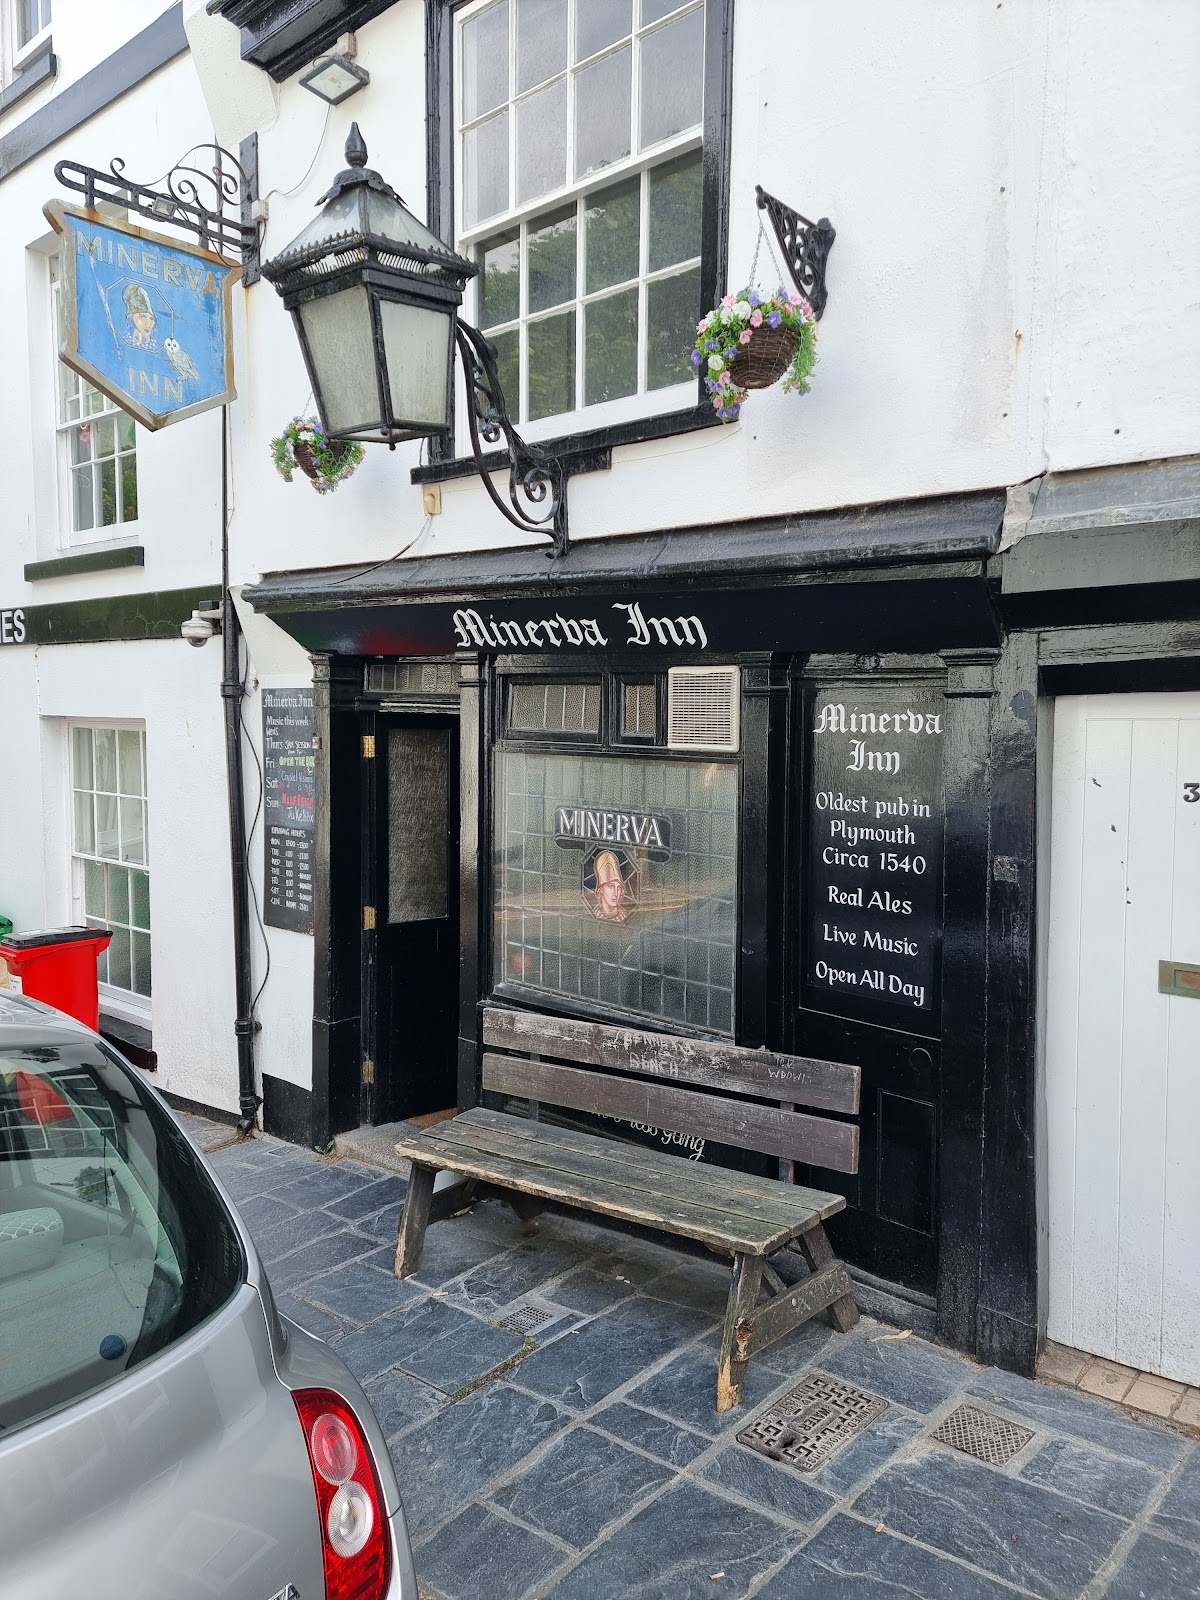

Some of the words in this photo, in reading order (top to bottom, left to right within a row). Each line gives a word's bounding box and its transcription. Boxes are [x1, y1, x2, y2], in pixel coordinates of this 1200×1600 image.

[76, 231, 221, 300] MINERVA
[127, 366, 184, 404] INN
[0, 608, 26, 643] ES
[452, 608, 608, 648] Minerva
[611, 601, 708, 650] Inn
[813, 702, 943, 735] Minerva
[846, 738, 901, 776] Inn
[815, 791, 869, 814] Oldest
[874, 796, 908, 823] pub
[911, 796, 931, 819] in
[1183, 783, 1200, 803] 3
[557, 808, 665, 848] MINERVA
[829, 819, 916, 847] Plymouth
[822, 846, 869, 869] Circa
[879, 851, 927, 875] 1540
[827, 885, 864, 908] Real
[867, 891, 913, 915] Ales
[823, 924, 857, 946] Live
[863, 930, 919, 957] Music
[815, 960, 858, 987] Open
[859, 969, 886, 991] All
[888, 974, 925, 1007] Day
[798, 1403, 833, 1433] WATER
